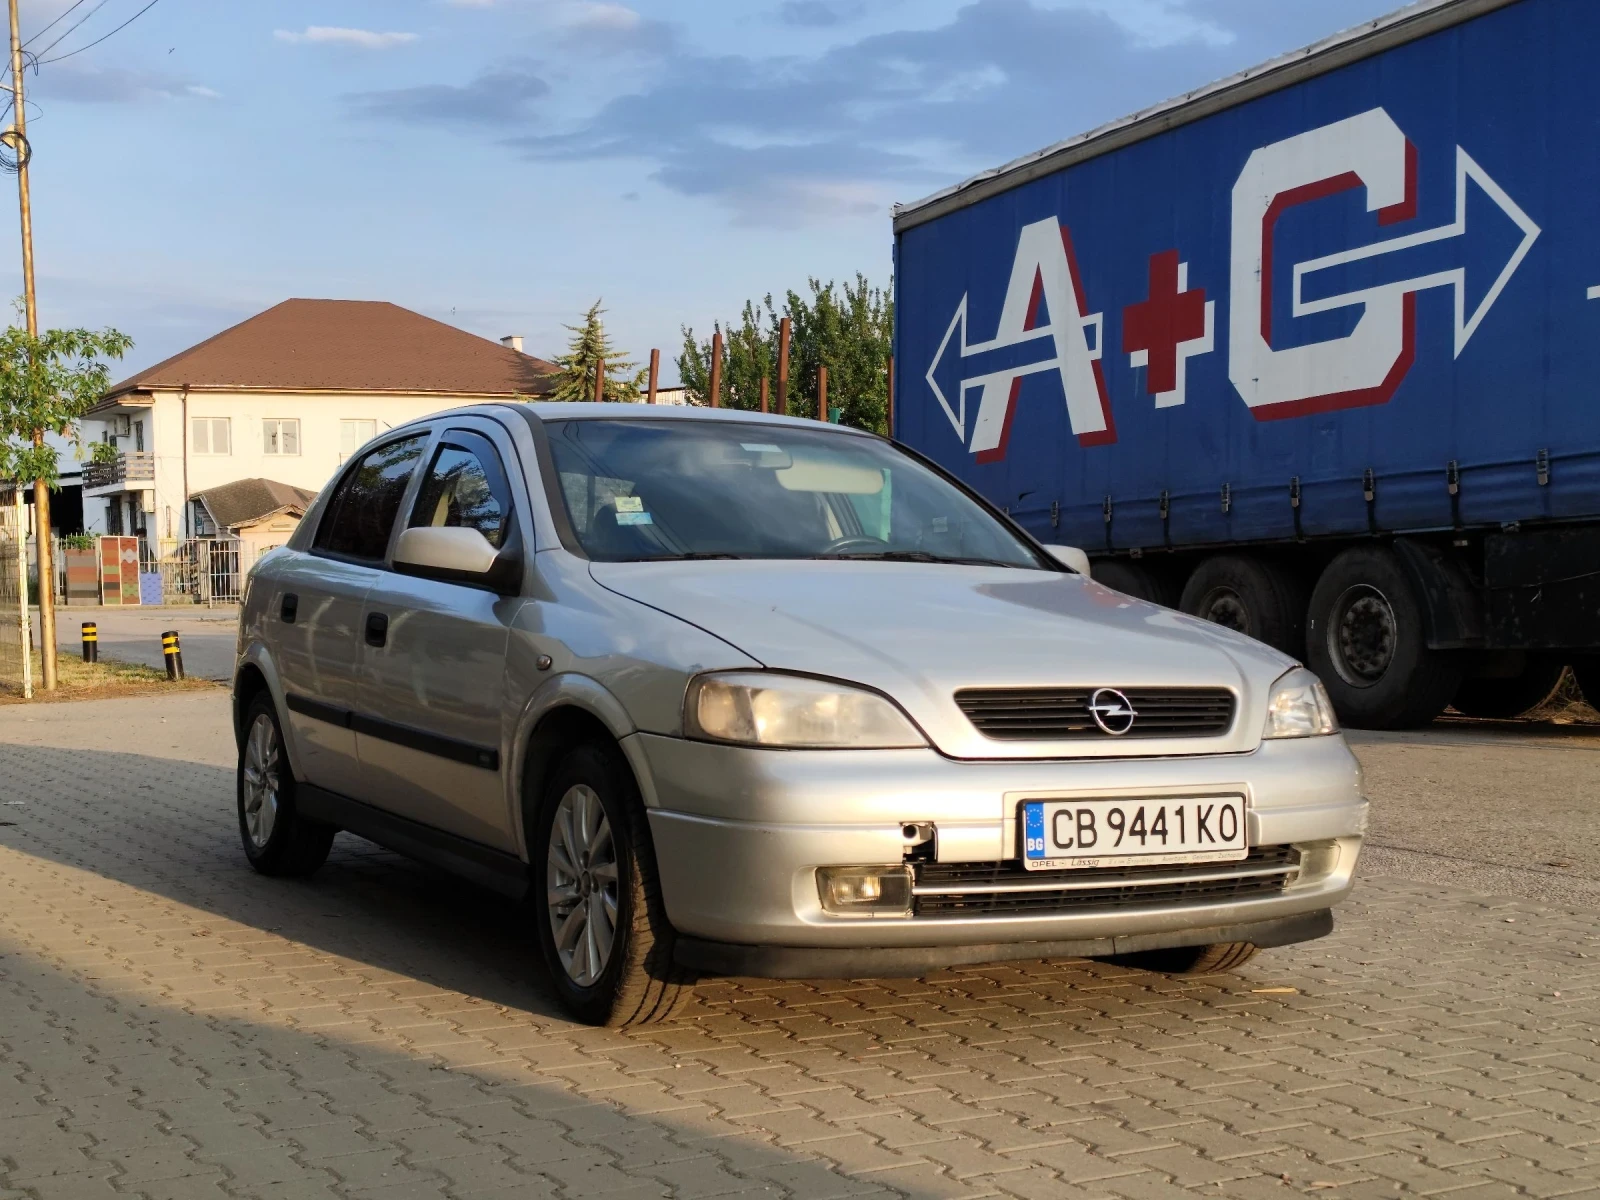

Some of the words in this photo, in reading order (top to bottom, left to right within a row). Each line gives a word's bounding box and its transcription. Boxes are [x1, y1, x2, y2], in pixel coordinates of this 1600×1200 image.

[1052, 808, 1098, 849] CB
[1107, 805, 1185, 848] 9441
[1197, 803, 1238, 844] KO
[1027, 838, 1043, 851] BG
[1032, 860, 1057, 868] OPEL
